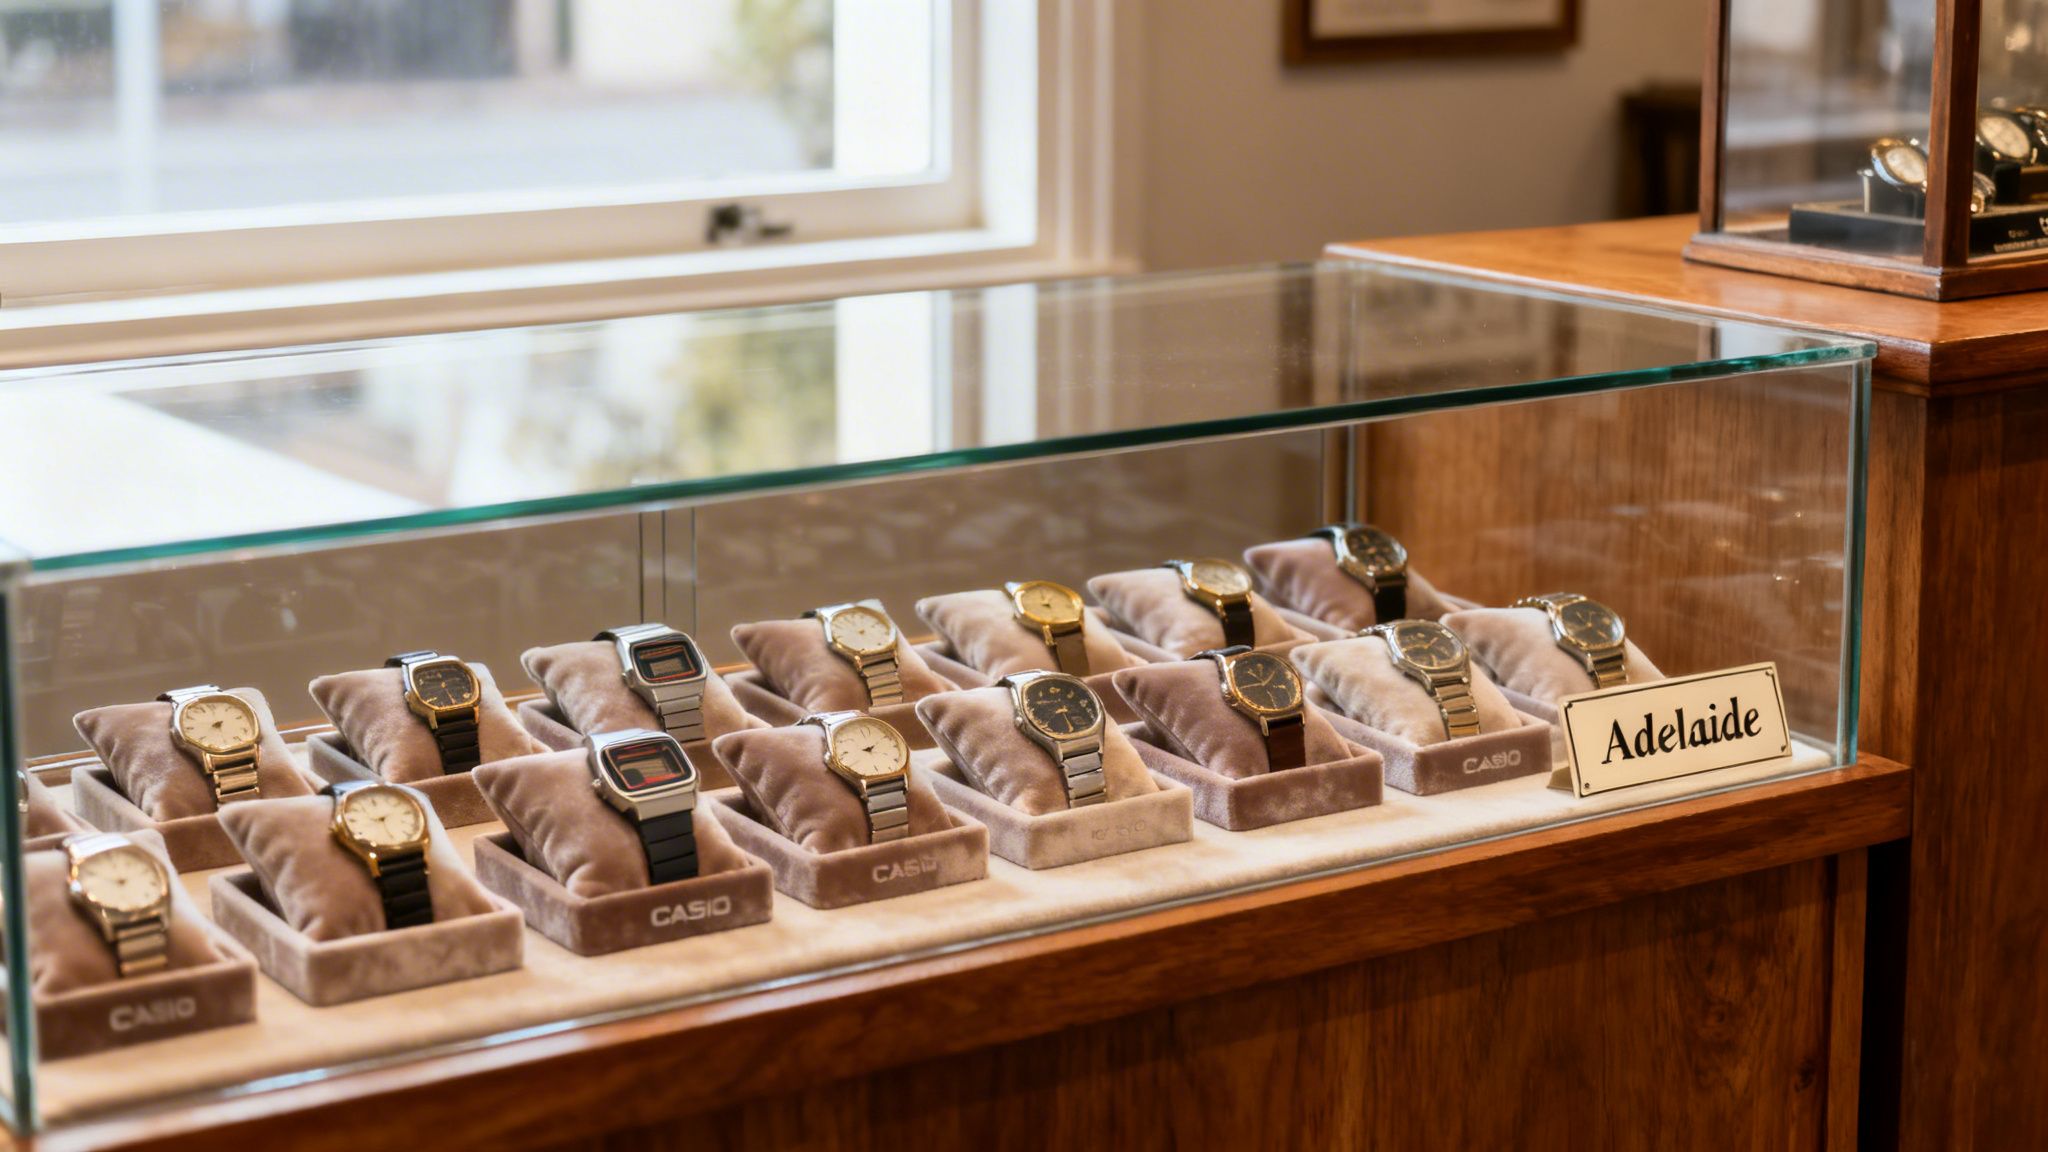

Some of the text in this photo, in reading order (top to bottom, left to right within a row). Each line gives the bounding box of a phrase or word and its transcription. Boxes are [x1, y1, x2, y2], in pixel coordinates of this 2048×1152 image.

[1601, 696, 1761, 764] Adelaide
[650, 895, 731, 927] CASIO
[109, 996, 196, 1032] CASIO
